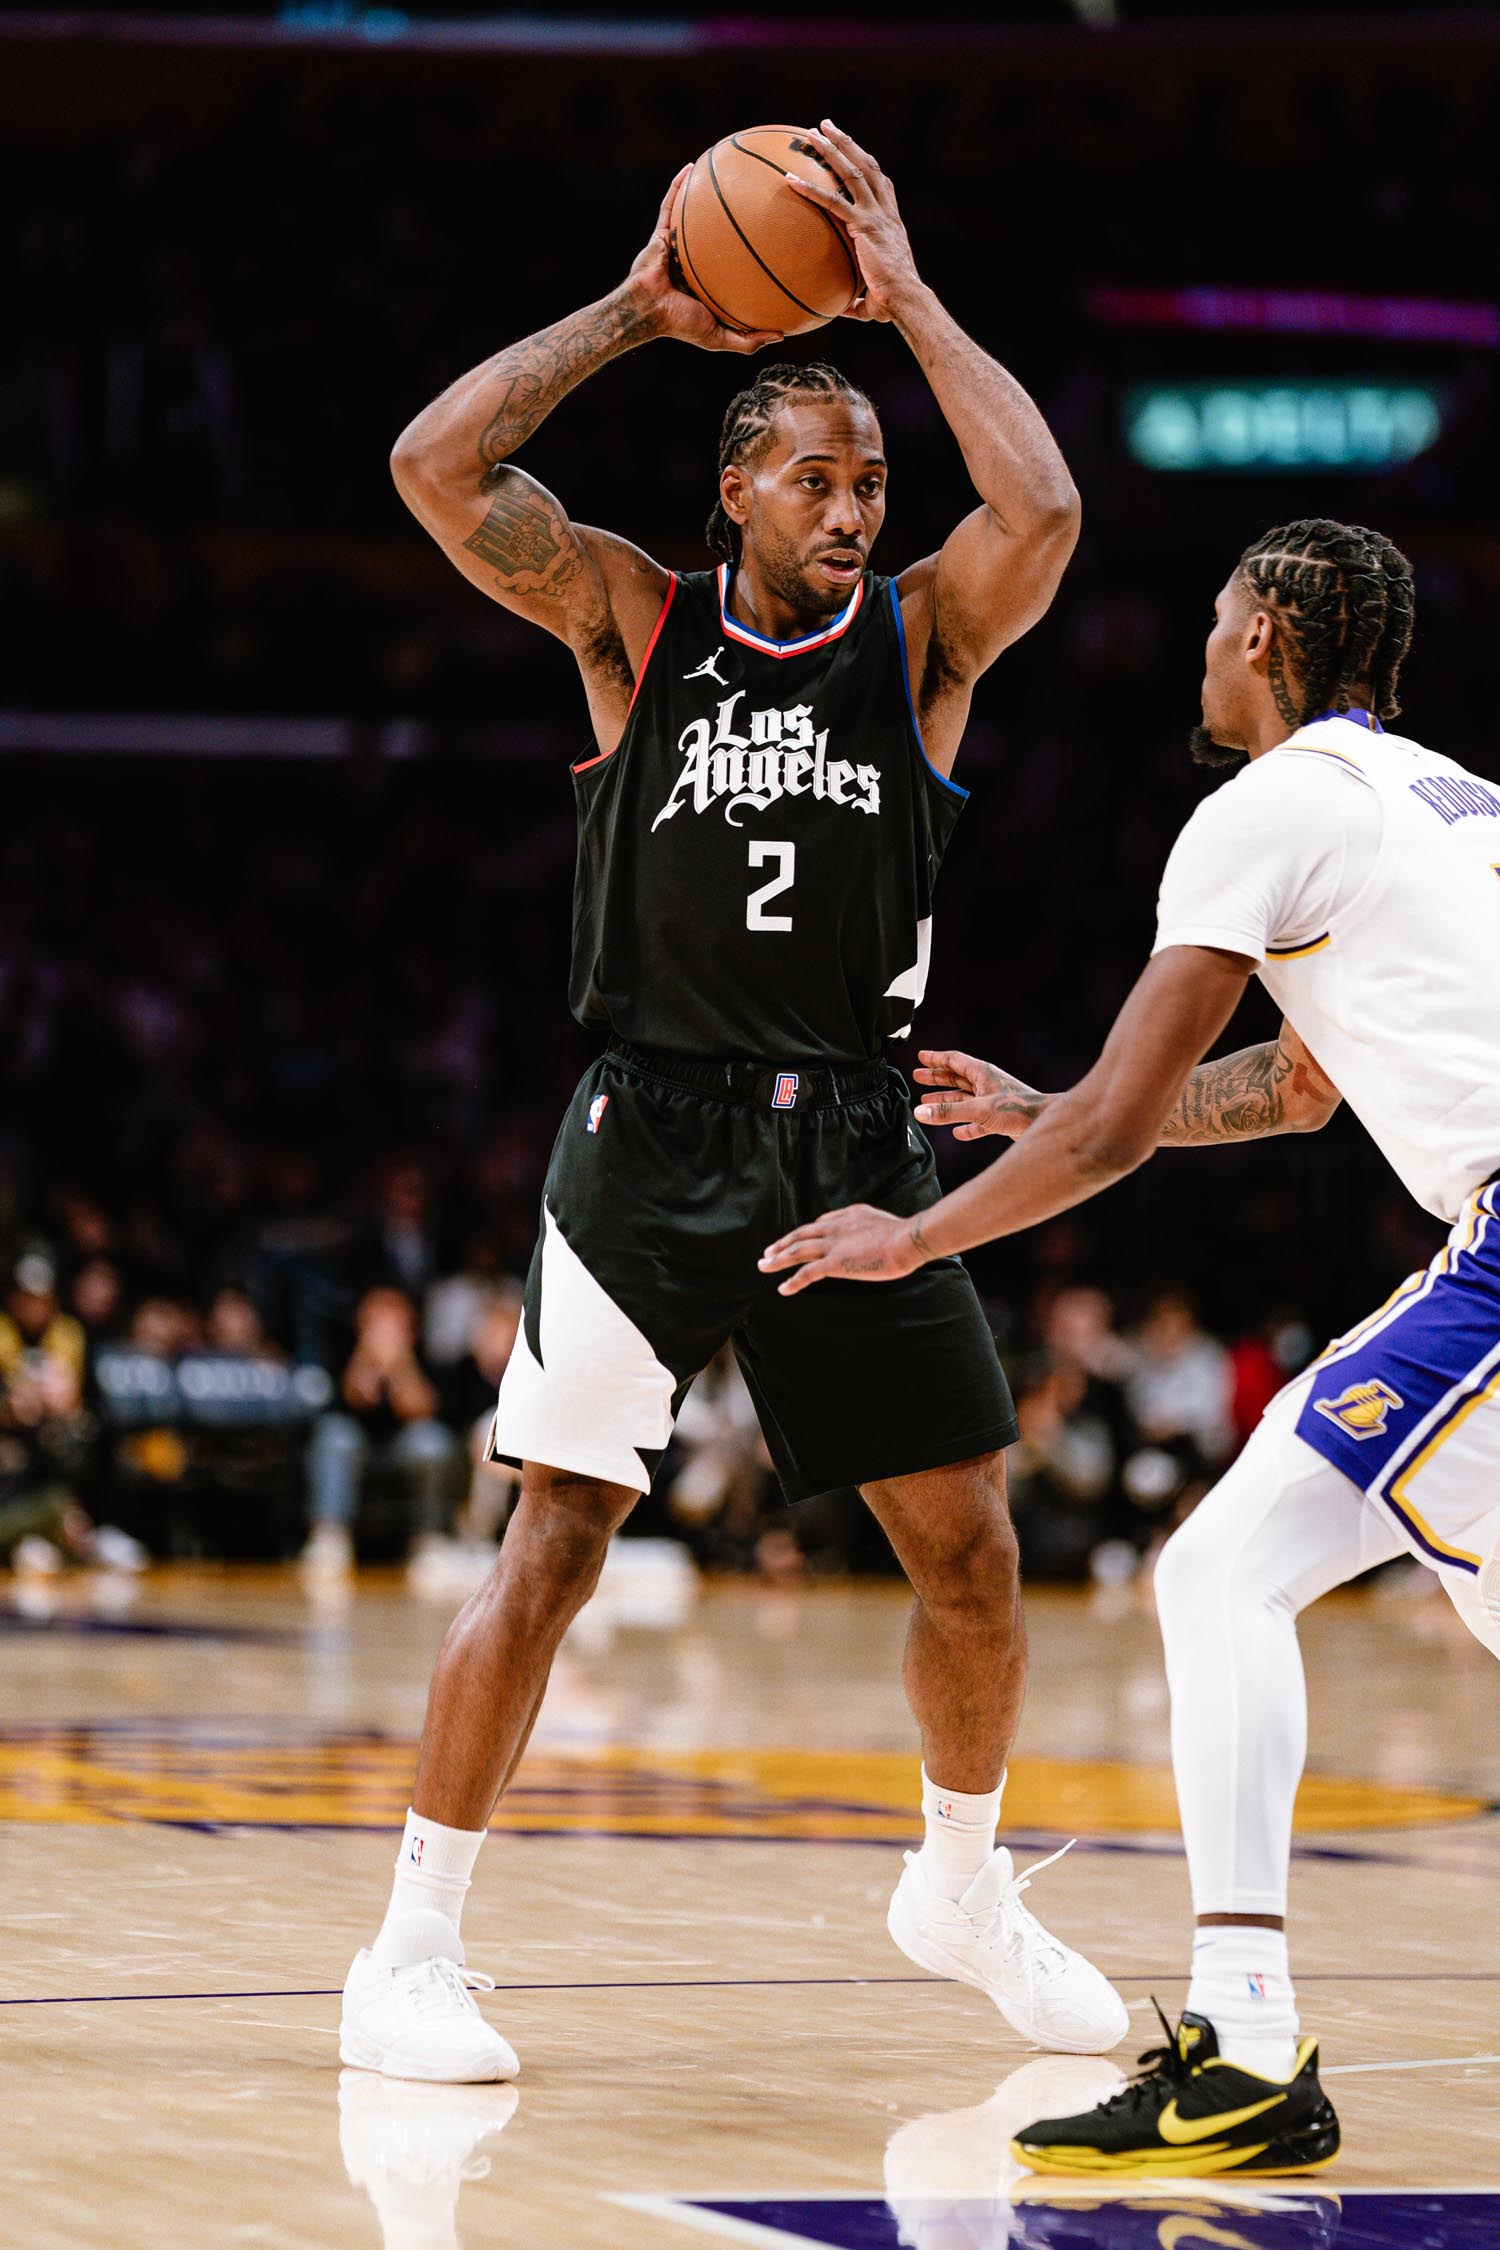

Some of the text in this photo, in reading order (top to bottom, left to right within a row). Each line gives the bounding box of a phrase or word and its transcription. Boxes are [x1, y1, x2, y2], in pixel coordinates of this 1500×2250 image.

[709, 689, 815, 750] Los
[650, 718, 882, 833] Angeles
[746, 840, 796, 932] 2
